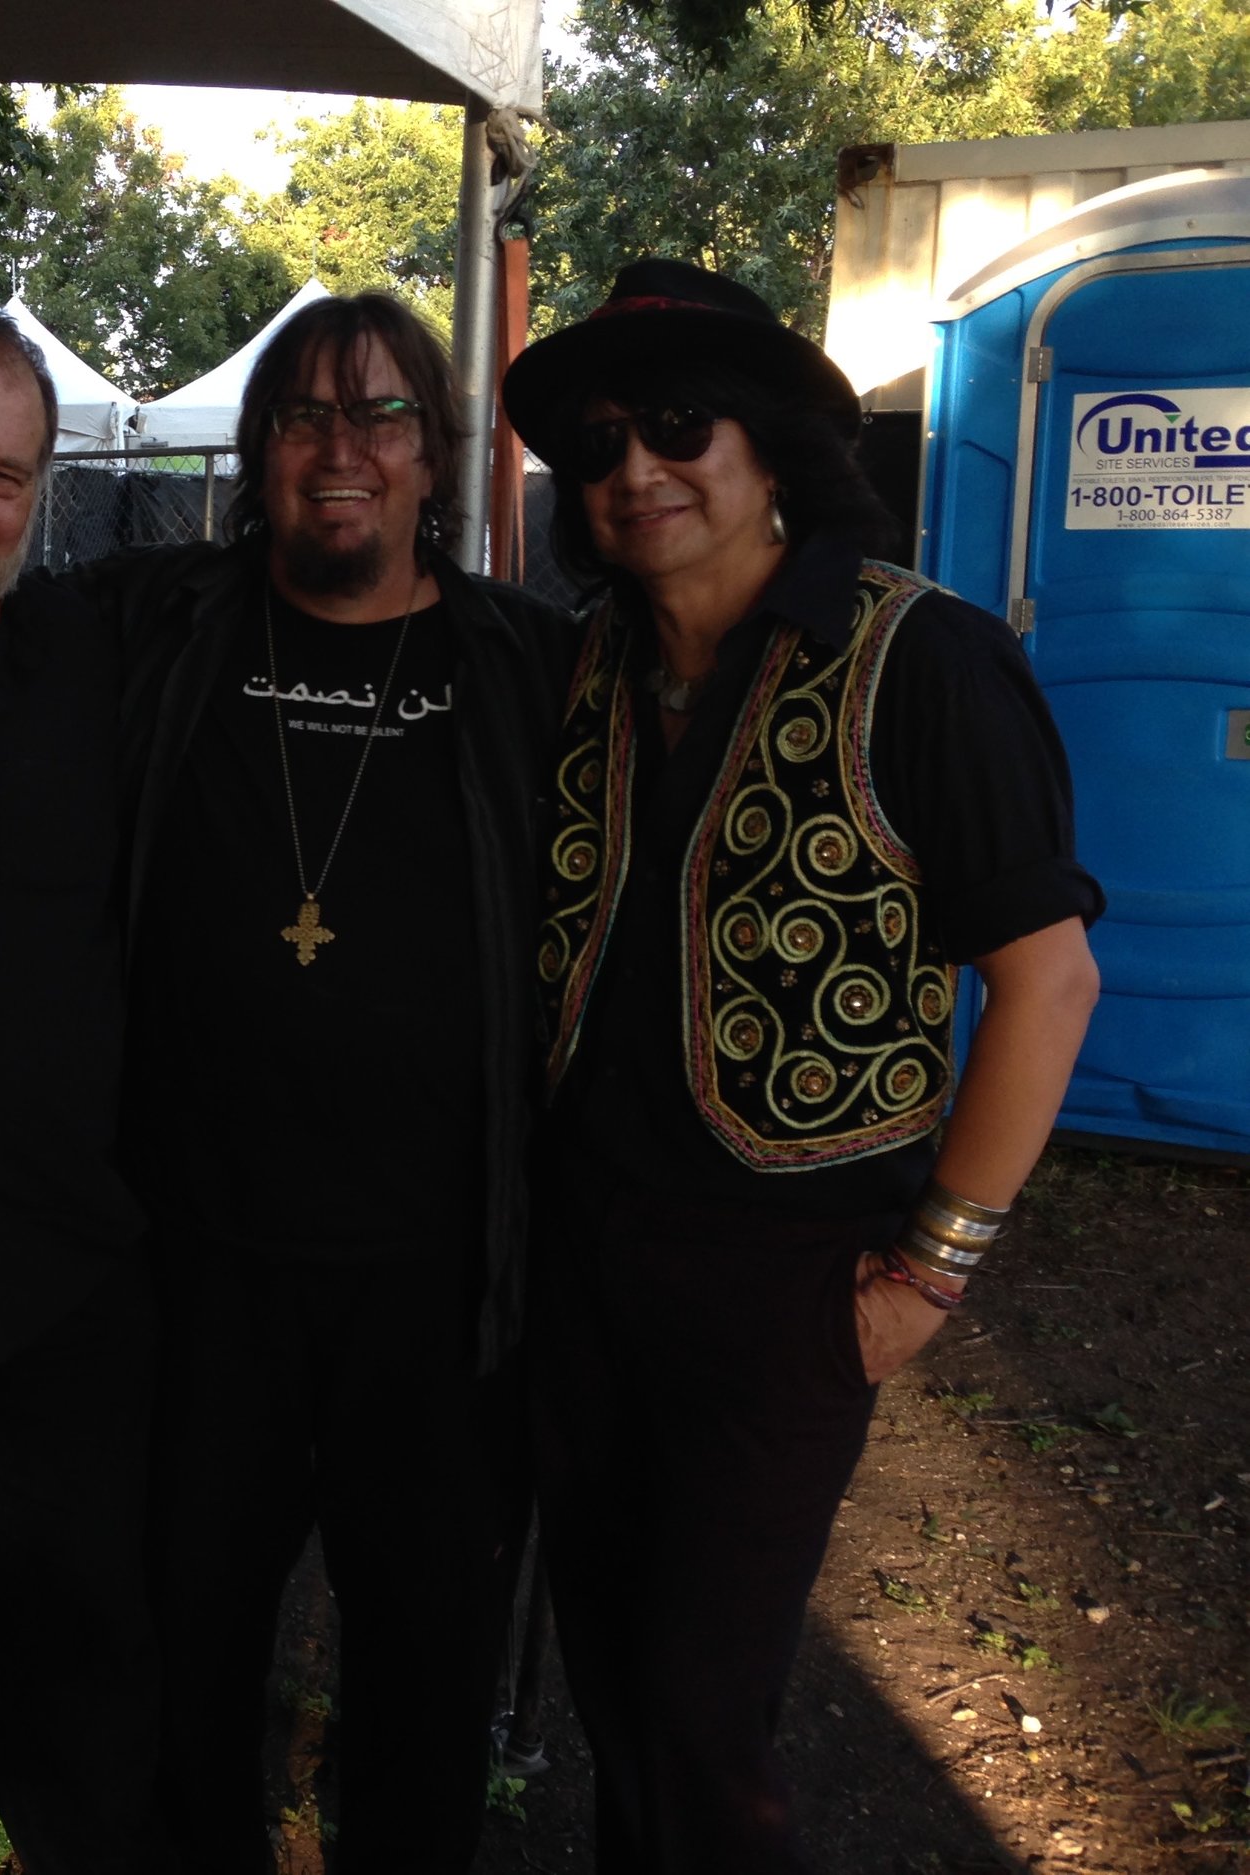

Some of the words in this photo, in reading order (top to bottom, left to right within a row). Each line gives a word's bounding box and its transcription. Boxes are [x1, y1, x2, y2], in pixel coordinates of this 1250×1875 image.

[1096, 459, 1123, 470] SITE
[1126, 457, 1191, 469] SERVICES
[1071, 484, 1250, 507] 1-800-TOILE
[1118, 508, 1233, 521] 1-800-864-5387
[243, 676, 376, 707] نصمت
[398, 683, 451, 720] لن
[288, 720, 304, 730] WE
[306, 722, 330, 732] WILL
[331, 724, 353, 734] NOT
[354, 725, 368, 736] BE
[371, 727, 405, 737] SILENT
